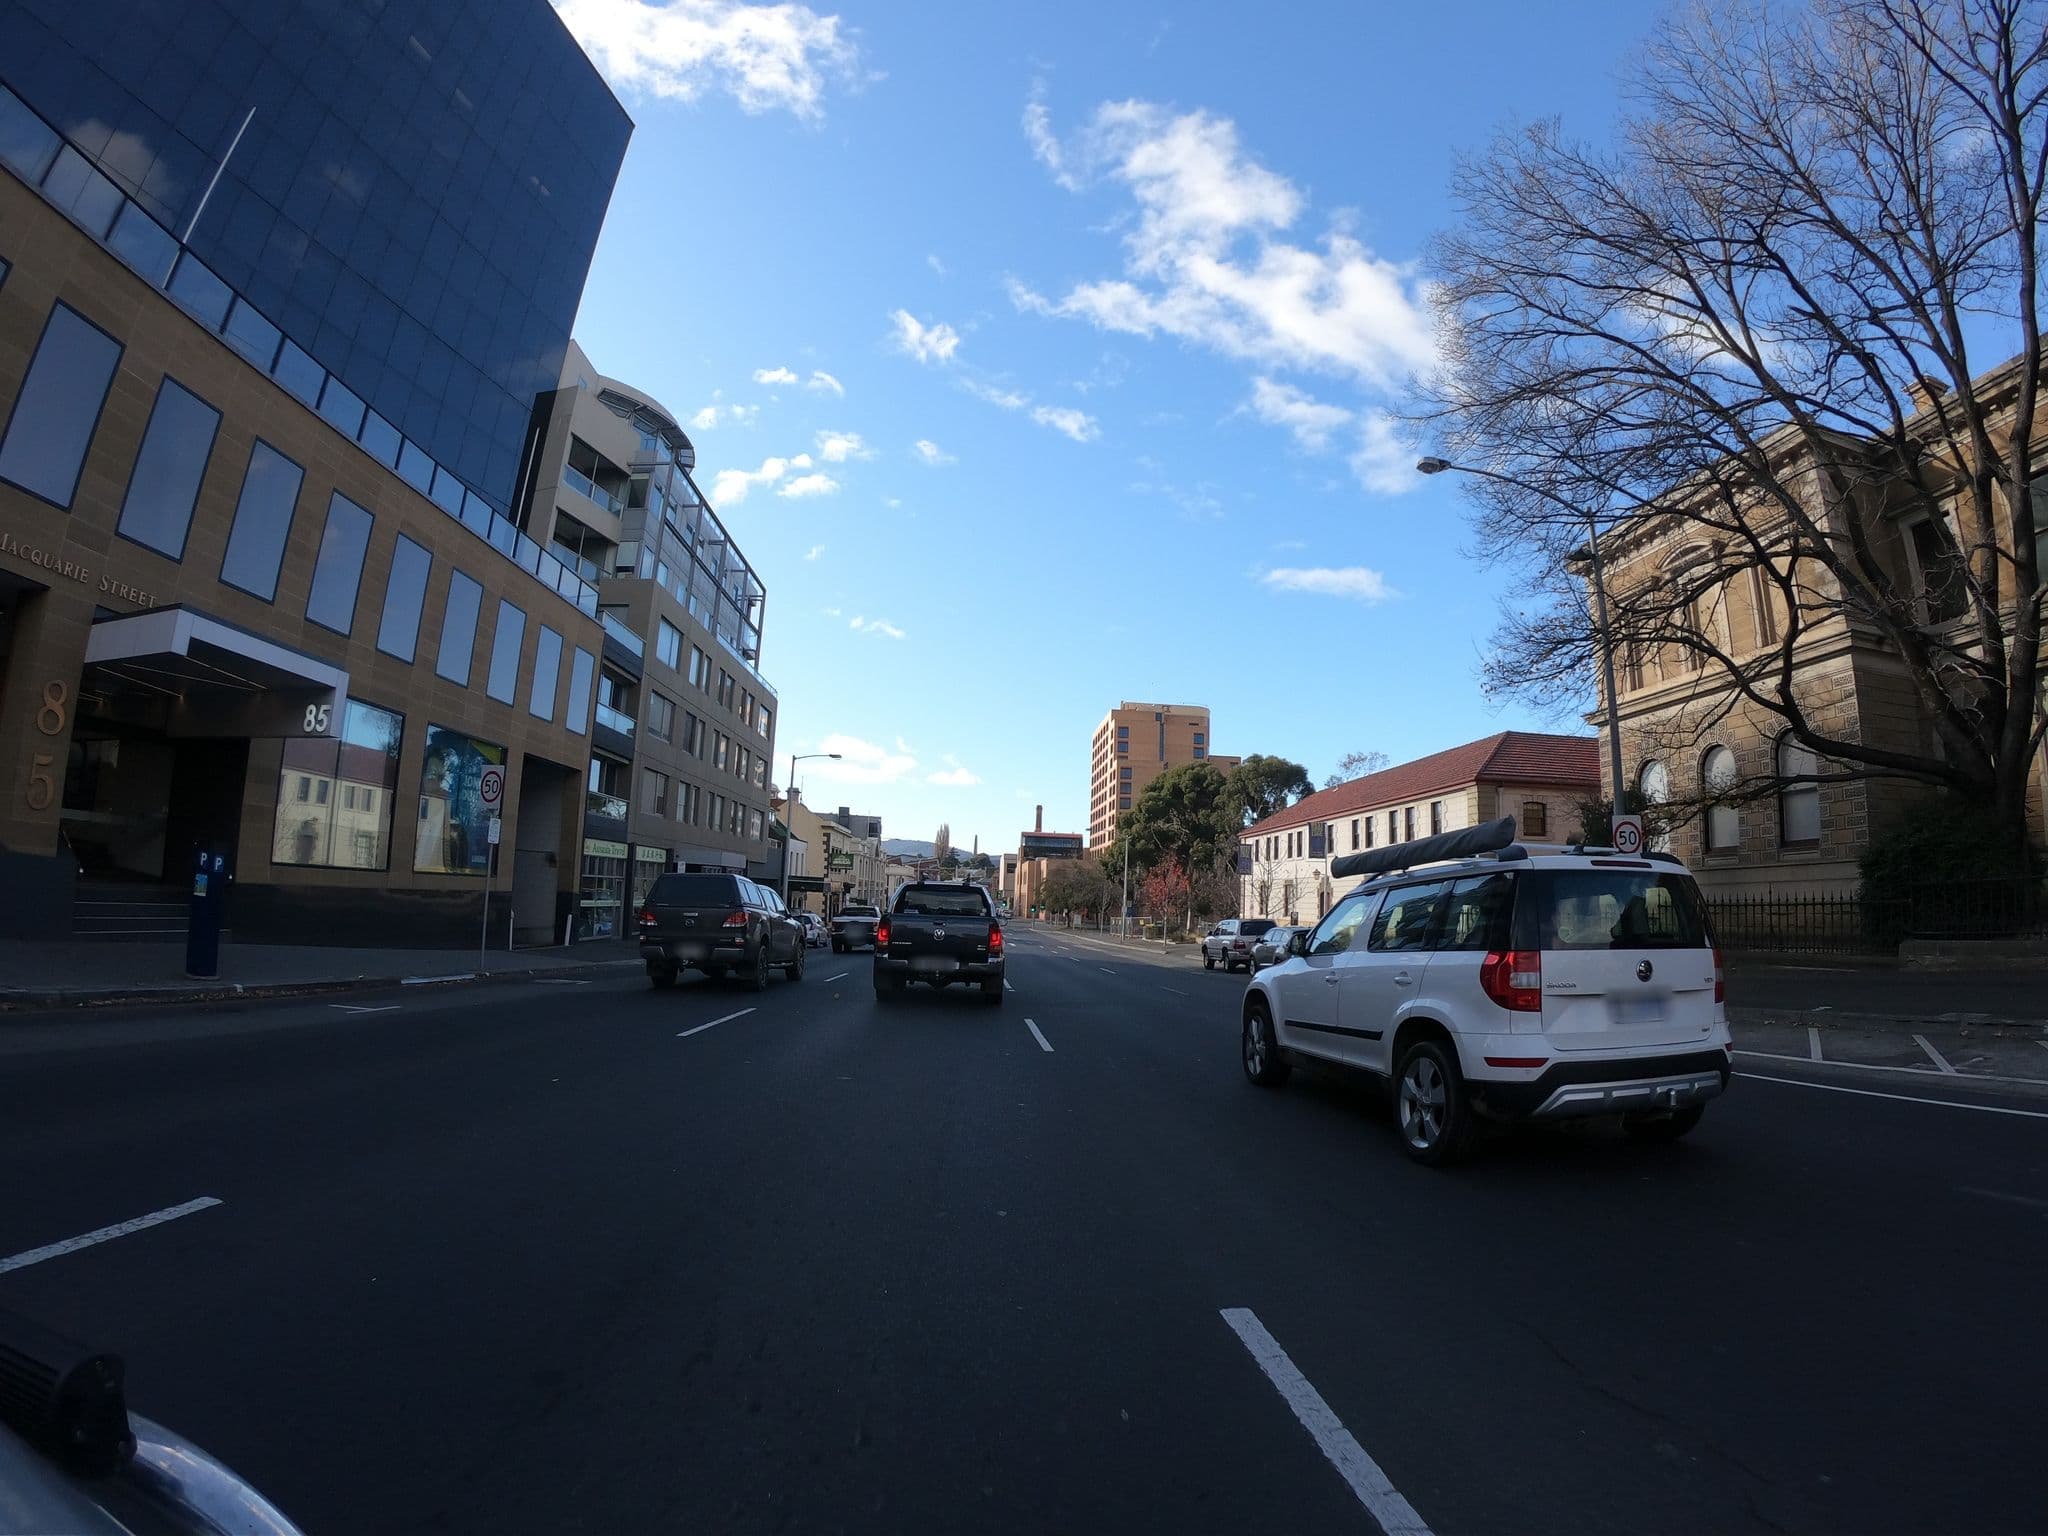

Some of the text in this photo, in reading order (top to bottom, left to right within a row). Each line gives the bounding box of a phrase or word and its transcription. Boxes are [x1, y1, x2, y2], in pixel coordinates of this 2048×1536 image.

[99, 575, 158, 609] STREET
[303, 704, 331, 732] 85
[484, 779, 499, 793] 50
[1618, 829, 1638, 847] 50
[200, 852, 208, 866] P
[215, 857, 223, 871] P
